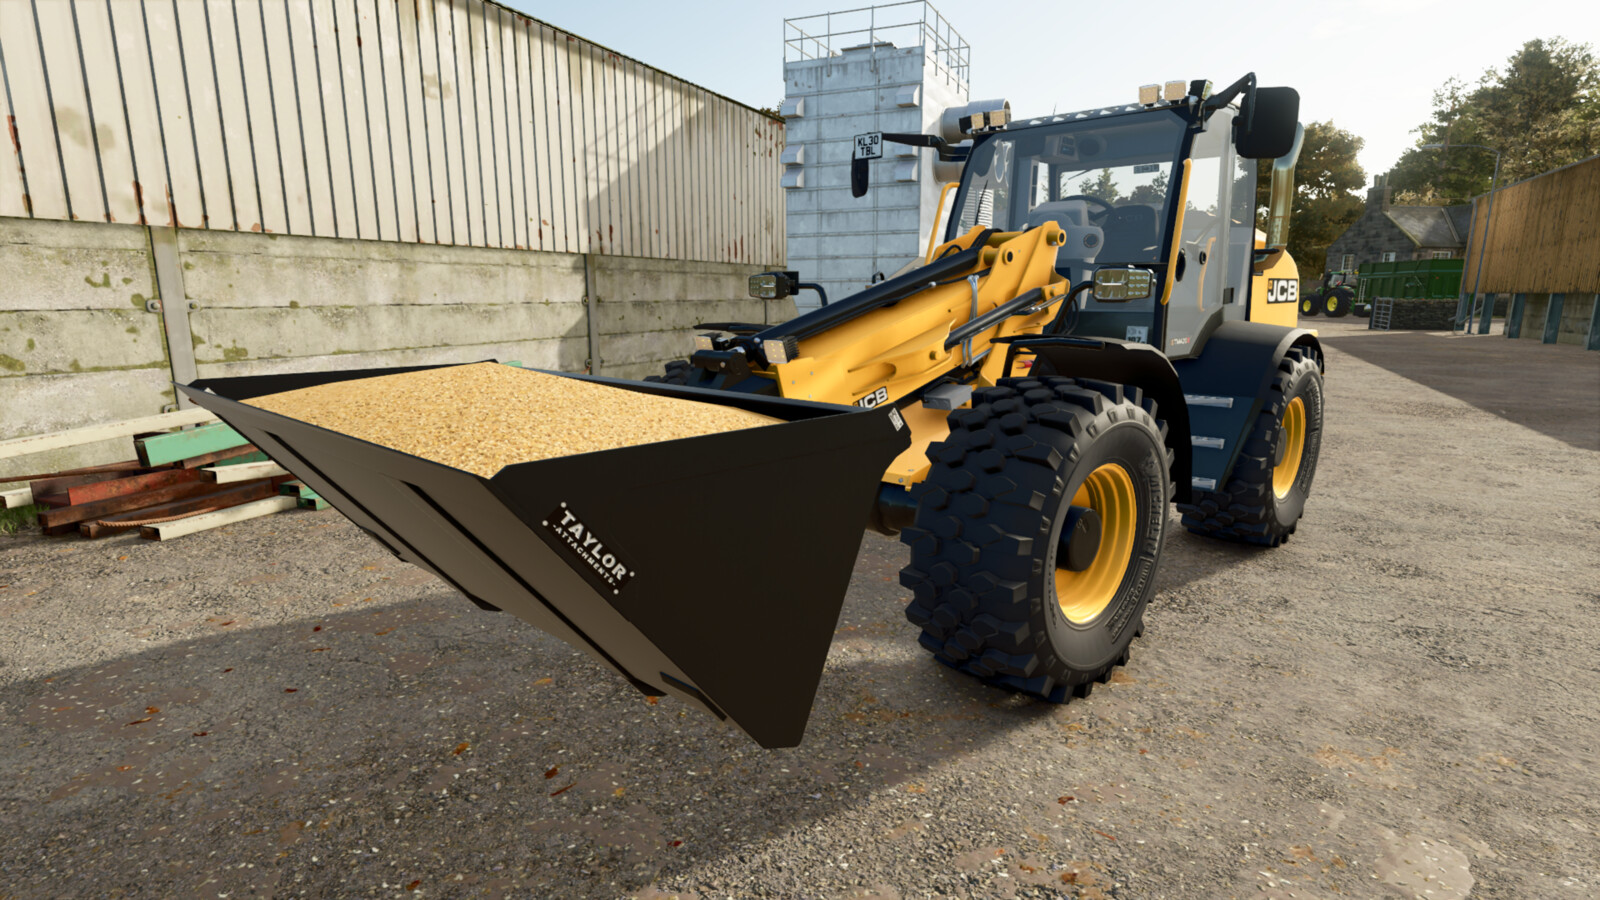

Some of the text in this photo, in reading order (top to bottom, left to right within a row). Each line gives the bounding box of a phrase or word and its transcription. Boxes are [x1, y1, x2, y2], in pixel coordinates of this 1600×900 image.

[857, 135, 879, 146] KL30
[860, 146, 876, 156] TBL
[1267, 279, 1297, 302] JCB
[561, 510, 627, 581] TAYLOR
